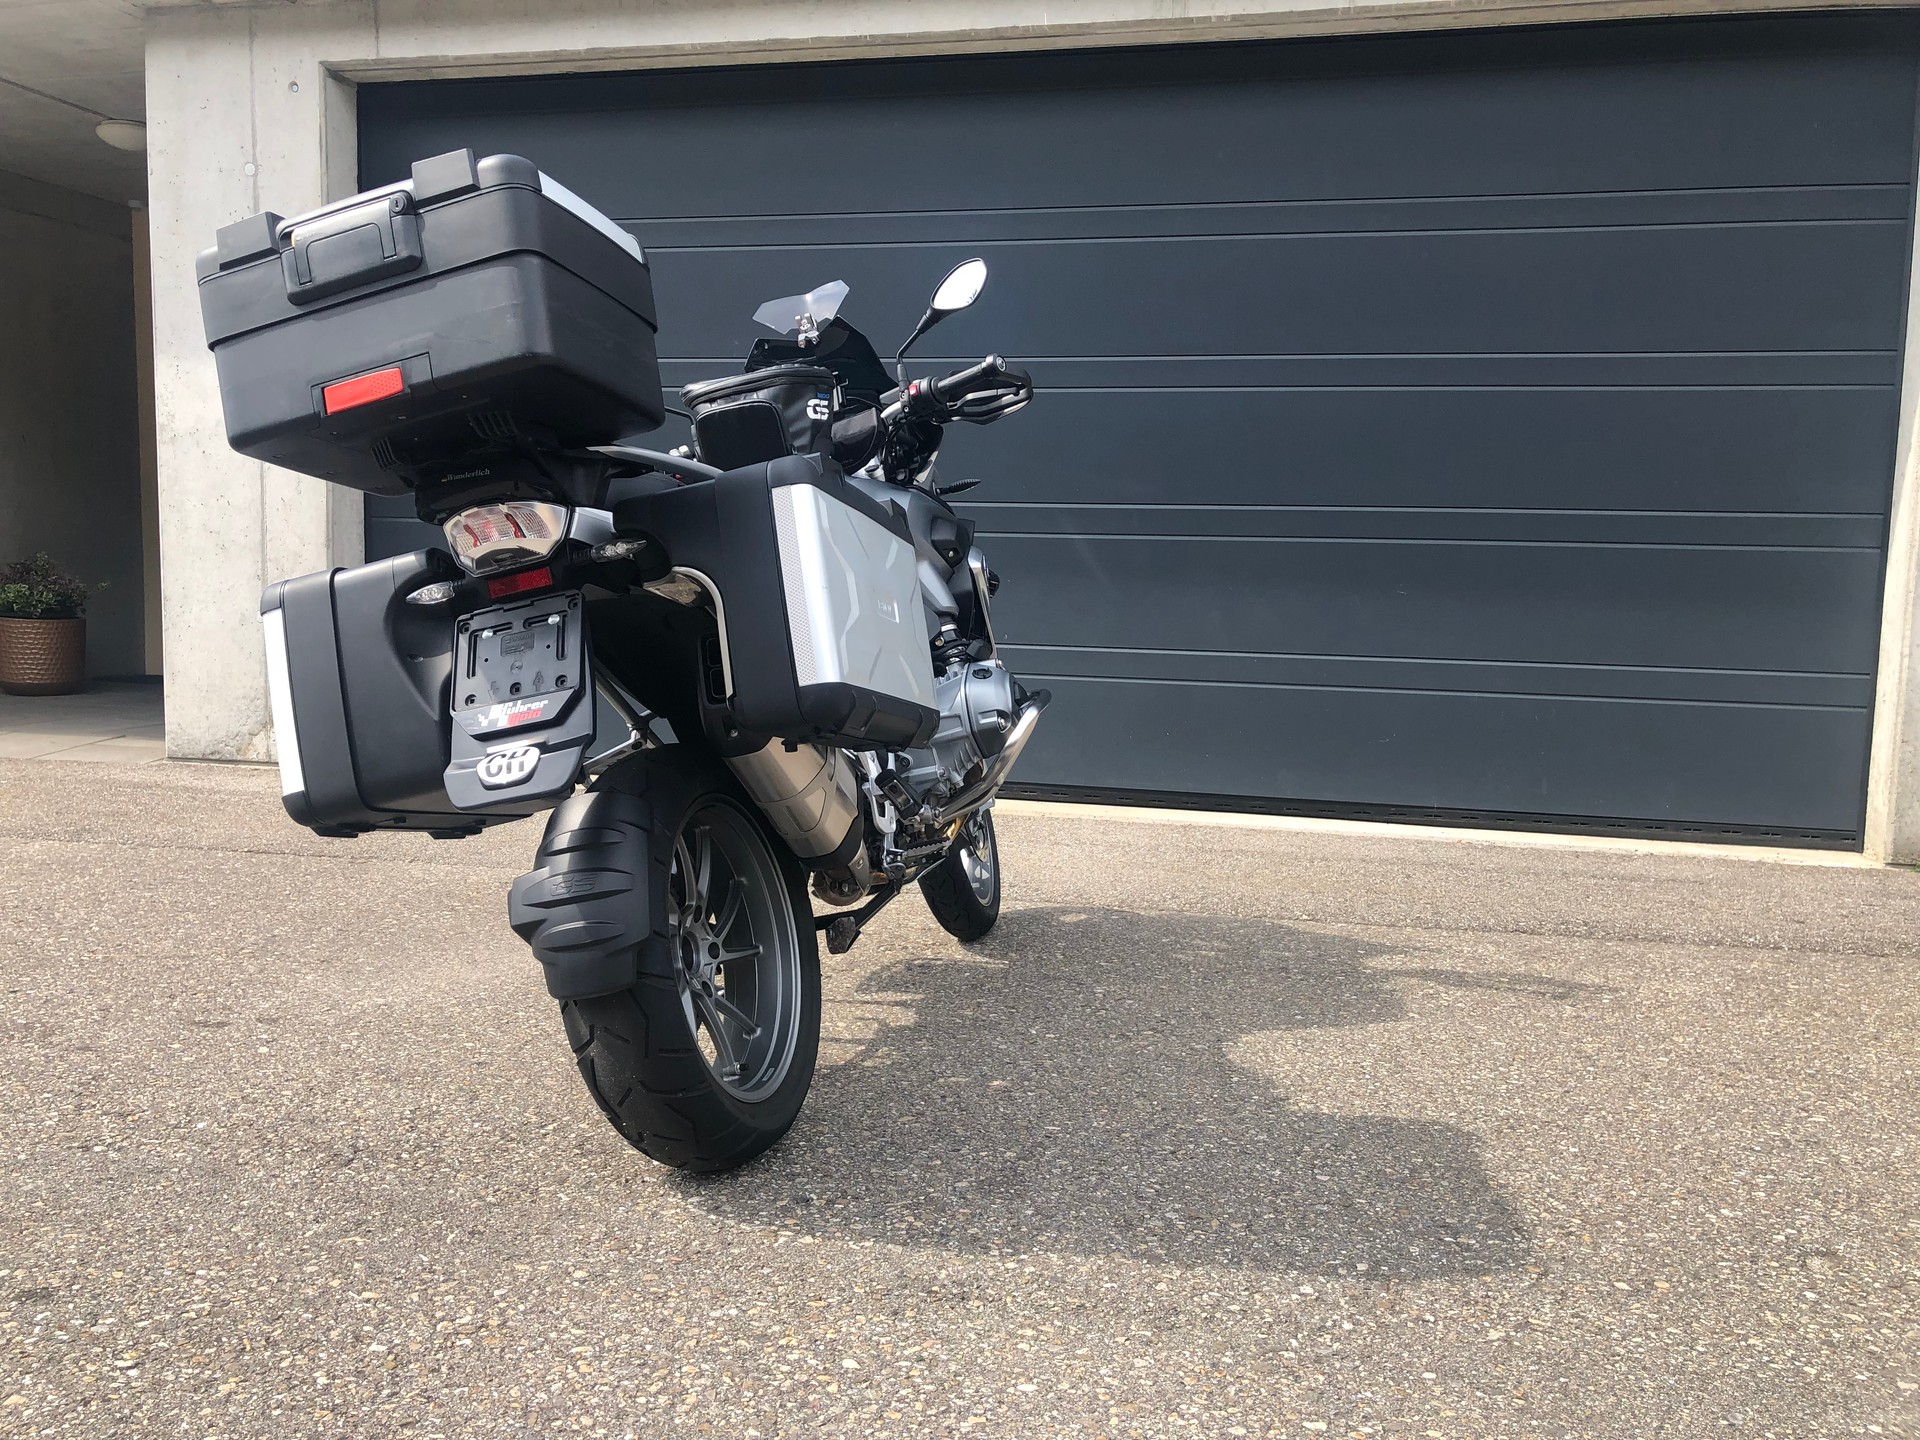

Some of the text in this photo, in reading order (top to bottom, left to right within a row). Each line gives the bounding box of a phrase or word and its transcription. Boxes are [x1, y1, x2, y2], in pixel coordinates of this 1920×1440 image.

[806, 398, 830, 421] GS
[447, 468, 491, 481] Wunderlich
[485, 748, 531, 778] CH
